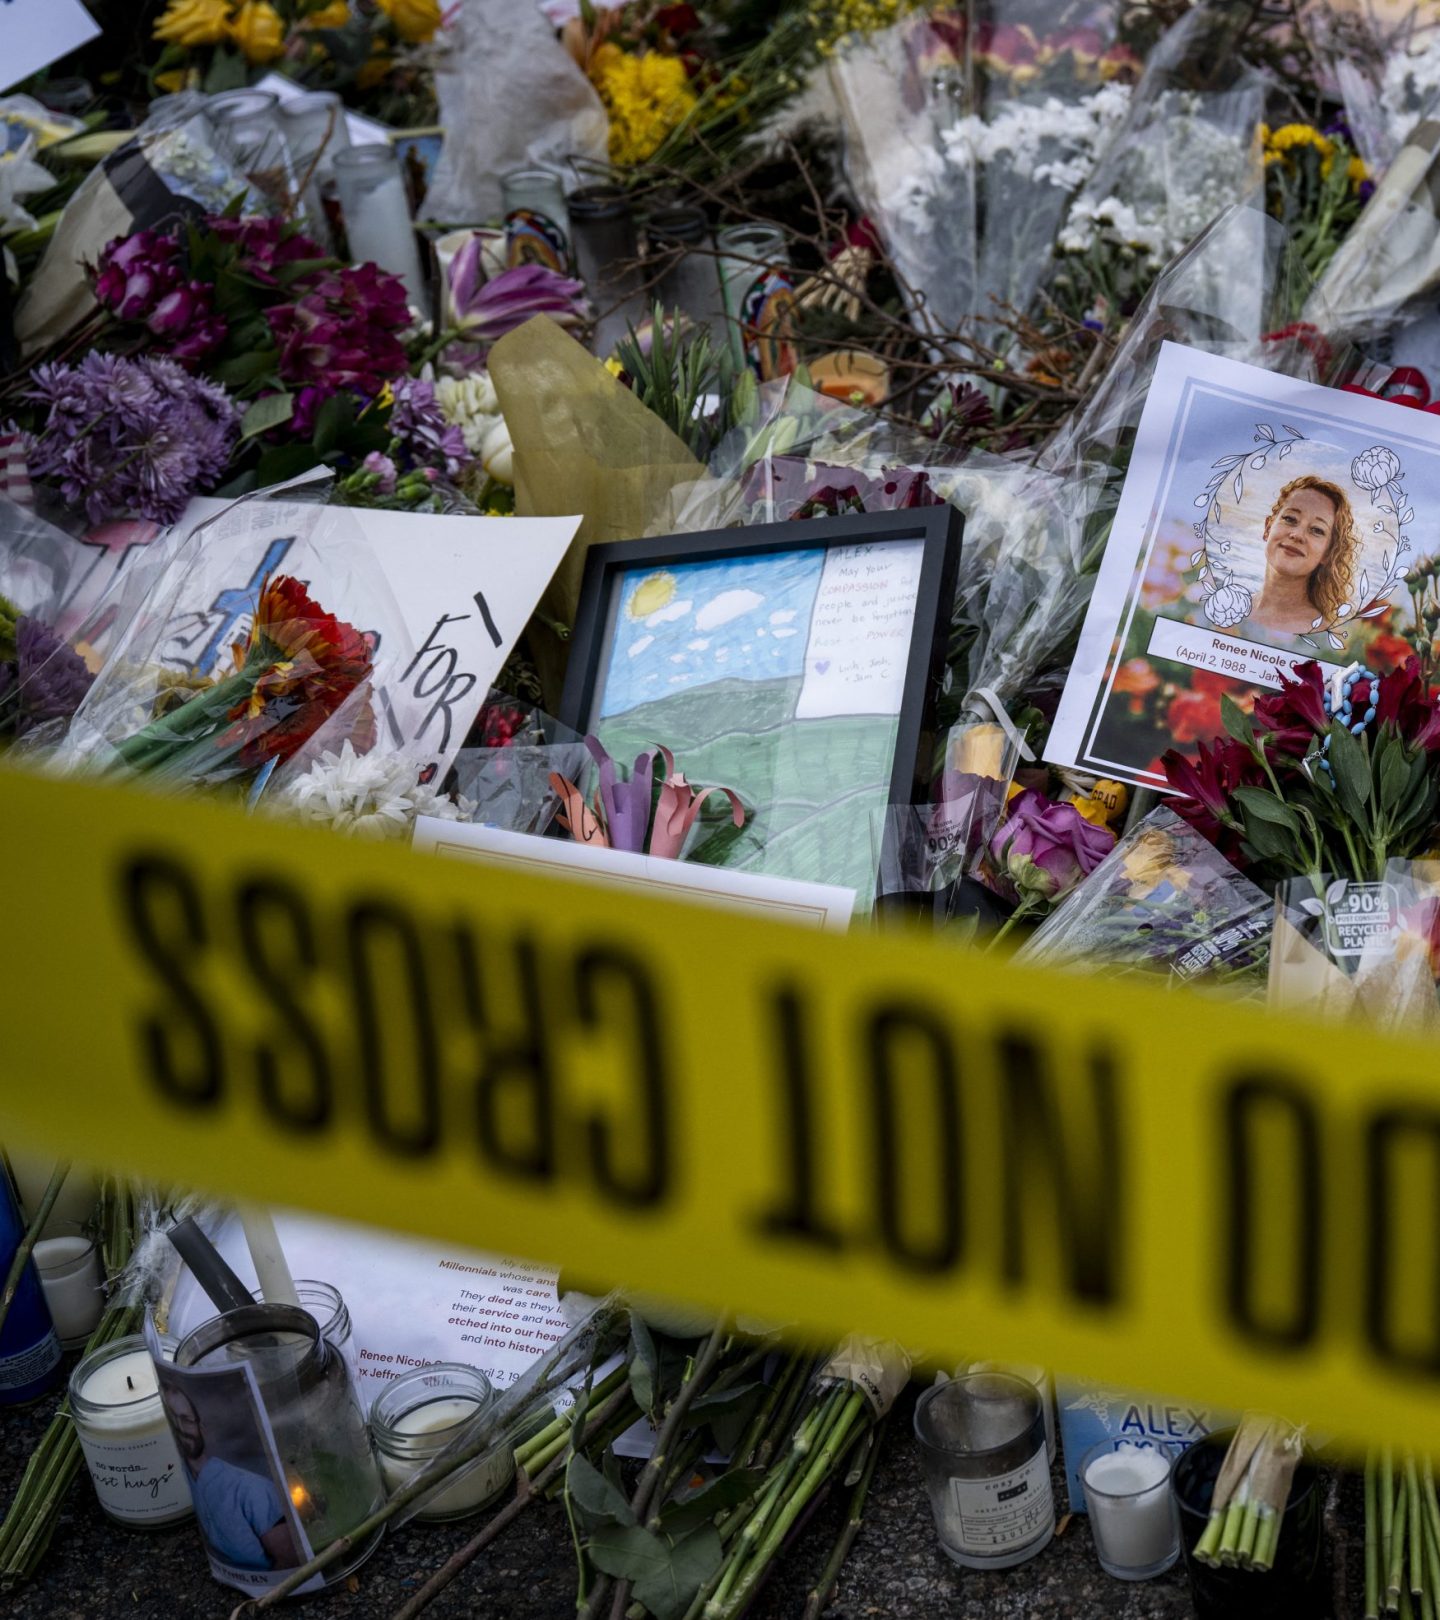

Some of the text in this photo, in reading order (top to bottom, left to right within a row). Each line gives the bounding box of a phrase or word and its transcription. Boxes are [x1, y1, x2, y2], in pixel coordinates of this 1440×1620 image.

[1176, 645, 1206, 663] (April
[1221, 658, 1247, 674] 1988
[1212, 638, 1248, 656] Renee
[1250, 649, 1287, 667] Nicole
[400, 612, 477, 754] FOR
[1348, 892, 1390, 913] 90%
[1337, 924, 1390, 937] RECYCLED
[120, 846, 672, 1210] CROSS
[752, 974, 1123, 1312] NOT
[438, 1259, 497, 1277] Millennials
[500, 1272, 534, 1283] whose
[459, 1289, 486, 1303] They
[488, 1295, 514, 1306] died
[515, 1300, 527, 1309] as
[530, 1301, 553, 1314] they
[502, 1285, 552, 1299] was care.
[451, 1302, 478, 1314] their
[479, 1307, 520, 1320] service
[521, 1313, 542, 1324] and
[448, 1316, 489, 1330] etched
[490, 1322, 512, 1334] into
[514, 1328, 534, 1338] our
[460, 1333, 483, 1344] and
[484, 1335, 506, 1348] into
[360, 1348, 394, 1363] Renee
[1121, 1403, 1211, 1437] ALEX
[95, 1461, 106, 1470] no
[123, 1472, 175, 1499] hugs
[251, 1574, 269, 1585] RN
